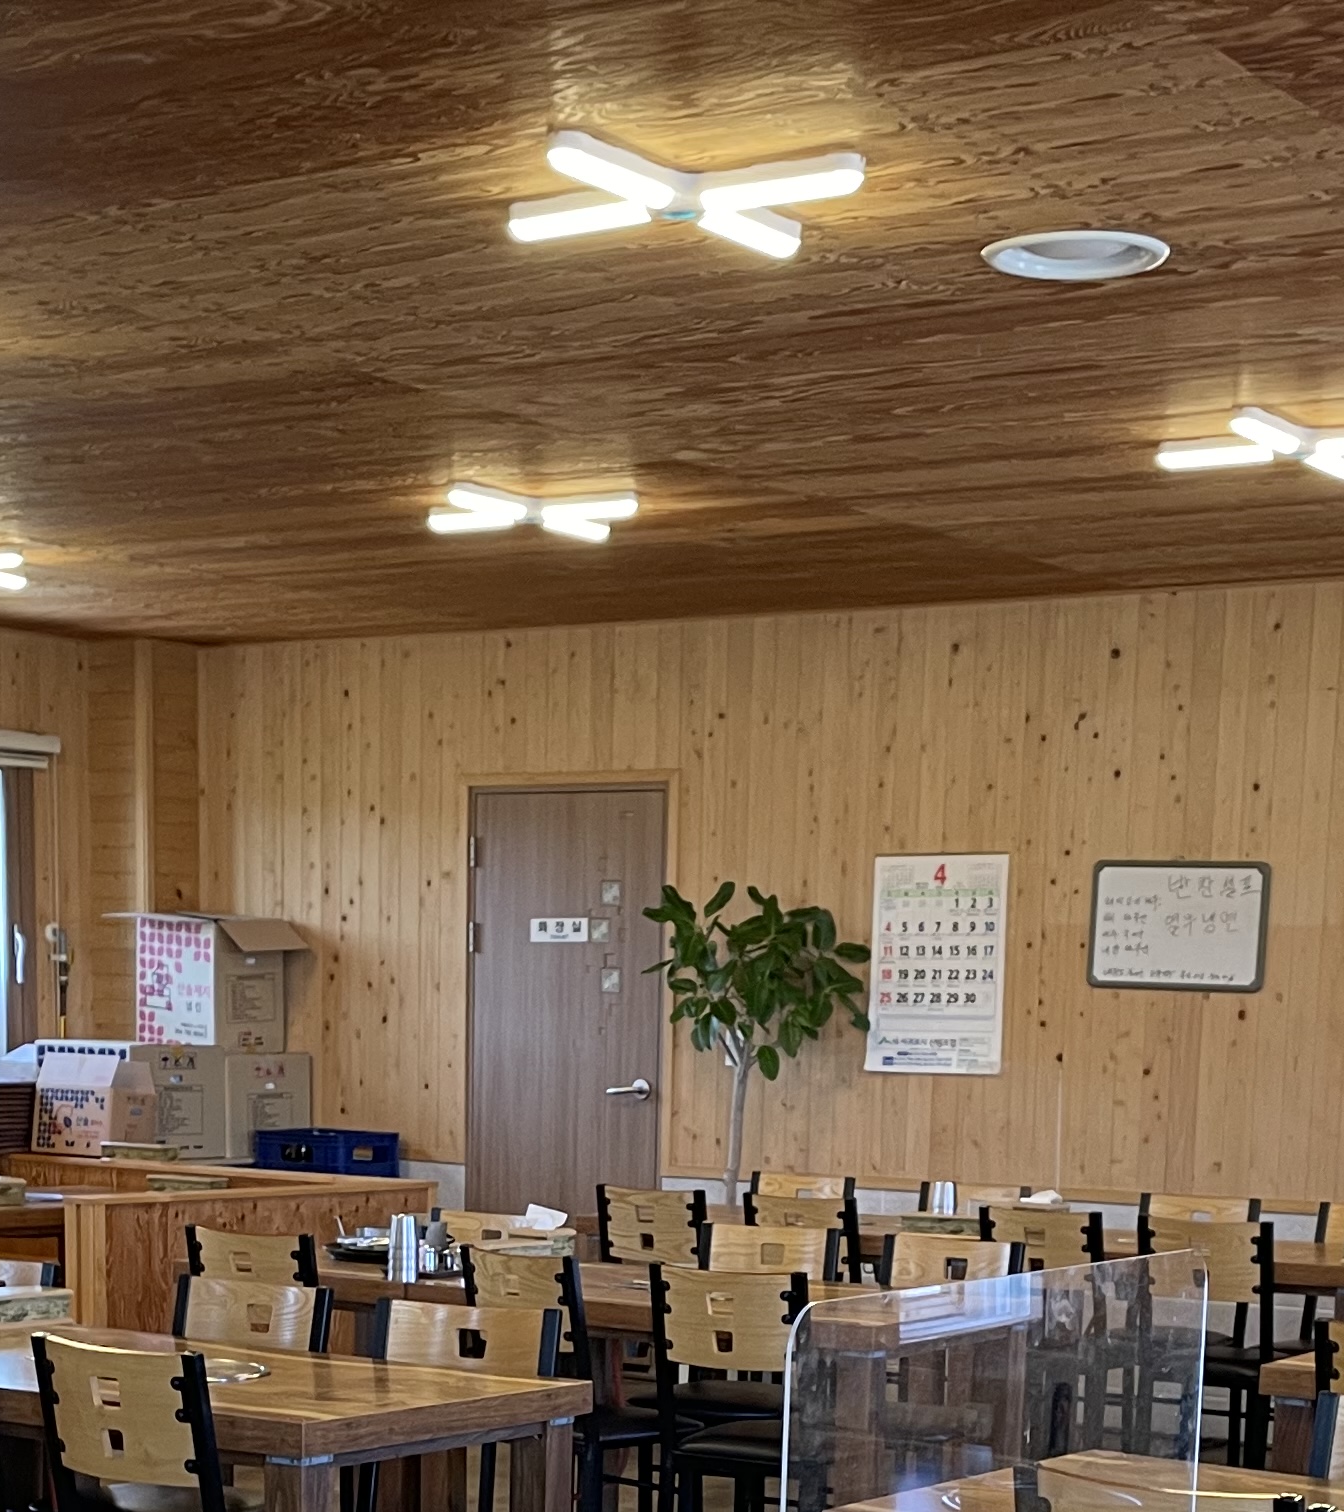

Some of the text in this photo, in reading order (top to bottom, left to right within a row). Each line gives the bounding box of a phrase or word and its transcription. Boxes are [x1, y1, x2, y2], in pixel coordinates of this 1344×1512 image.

[934, 863, 947, 885] 4
[955, 898, 993, 908] 1 2 3
[538, 921, 581, 933] 화장실
[885, 921, 995, 932] 4 5 6 7 8 9 10
[884, 945, 993, 956] 11 12 13 14 15 16 17
[882, 969, 993, 980] 18 19 20 21 22 23 24
[880, 993, 976, 1003] 25 26 27 28 29 30
